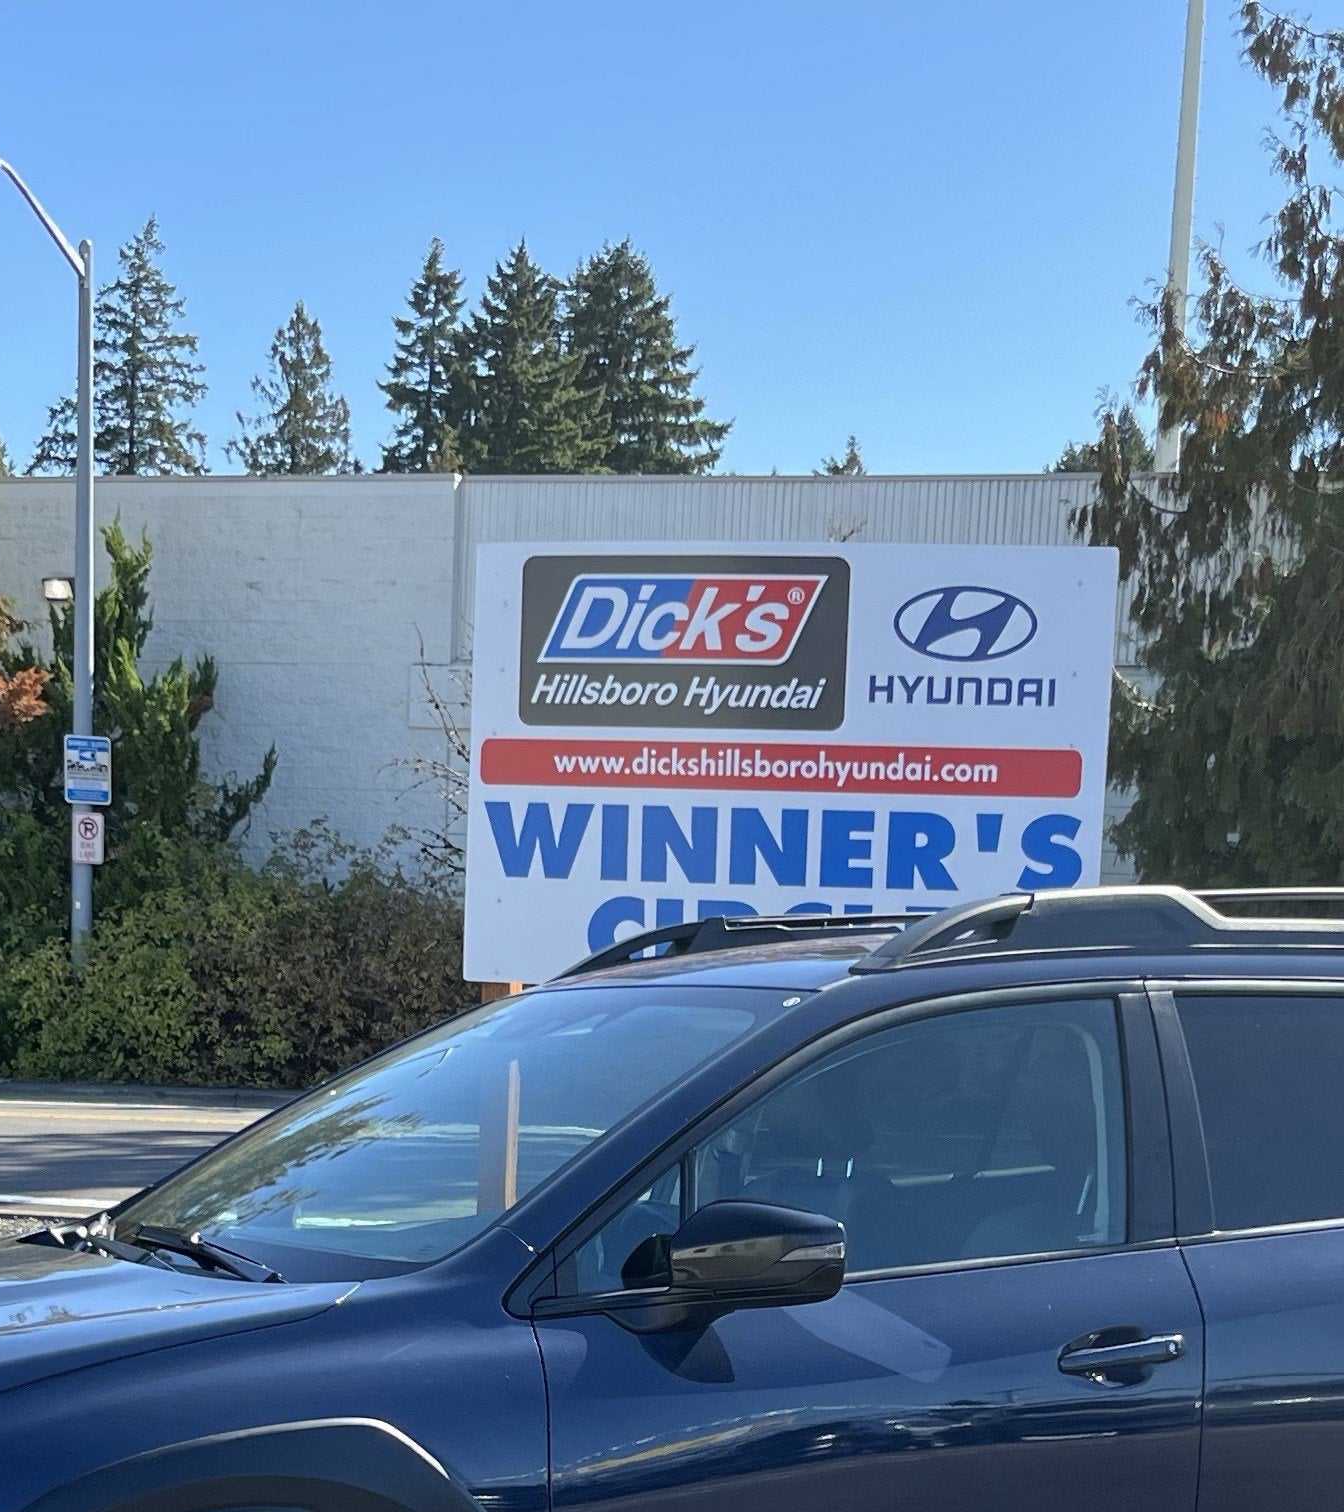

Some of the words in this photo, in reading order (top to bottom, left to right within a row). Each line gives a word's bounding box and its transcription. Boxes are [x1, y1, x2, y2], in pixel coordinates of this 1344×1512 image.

[530, 673, 677, 707] Hillsboro
[683, 676, 826, 715] Hyundai
[869, 674, 1056, 707] HYUNDAI
[554, 746, 998, 787] www.dickshillsborohyundai.com
[485, 801, 1083, 890] WINNER'S
